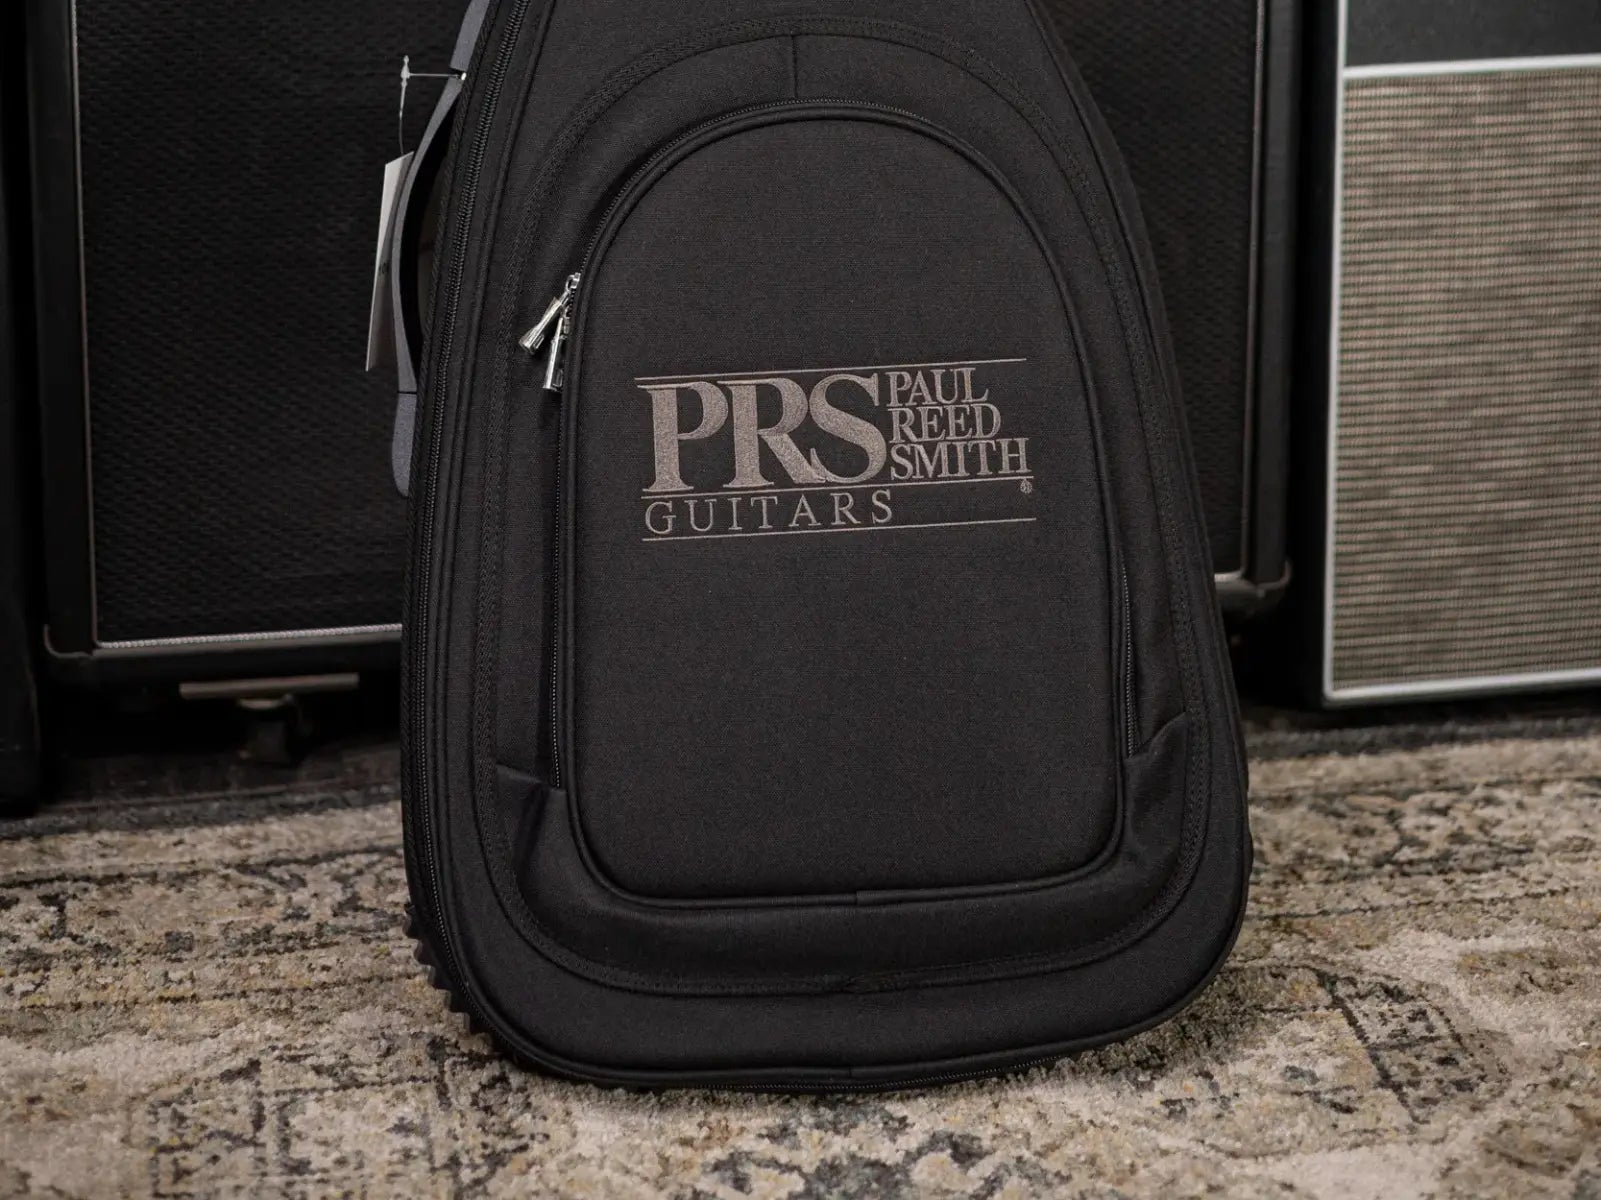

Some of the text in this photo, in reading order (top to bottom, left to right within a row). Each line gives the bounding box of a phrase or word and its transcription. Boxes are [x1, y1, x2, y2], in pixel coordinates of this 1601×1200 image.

[885, 367, 988, 407] PAUL
[637, 373, 888, 492] PRS
[887, 403, 1001, 443] REED
[890, 438, 1032, 481] SMITH
[644, 488, 893, 535] GUITARS
